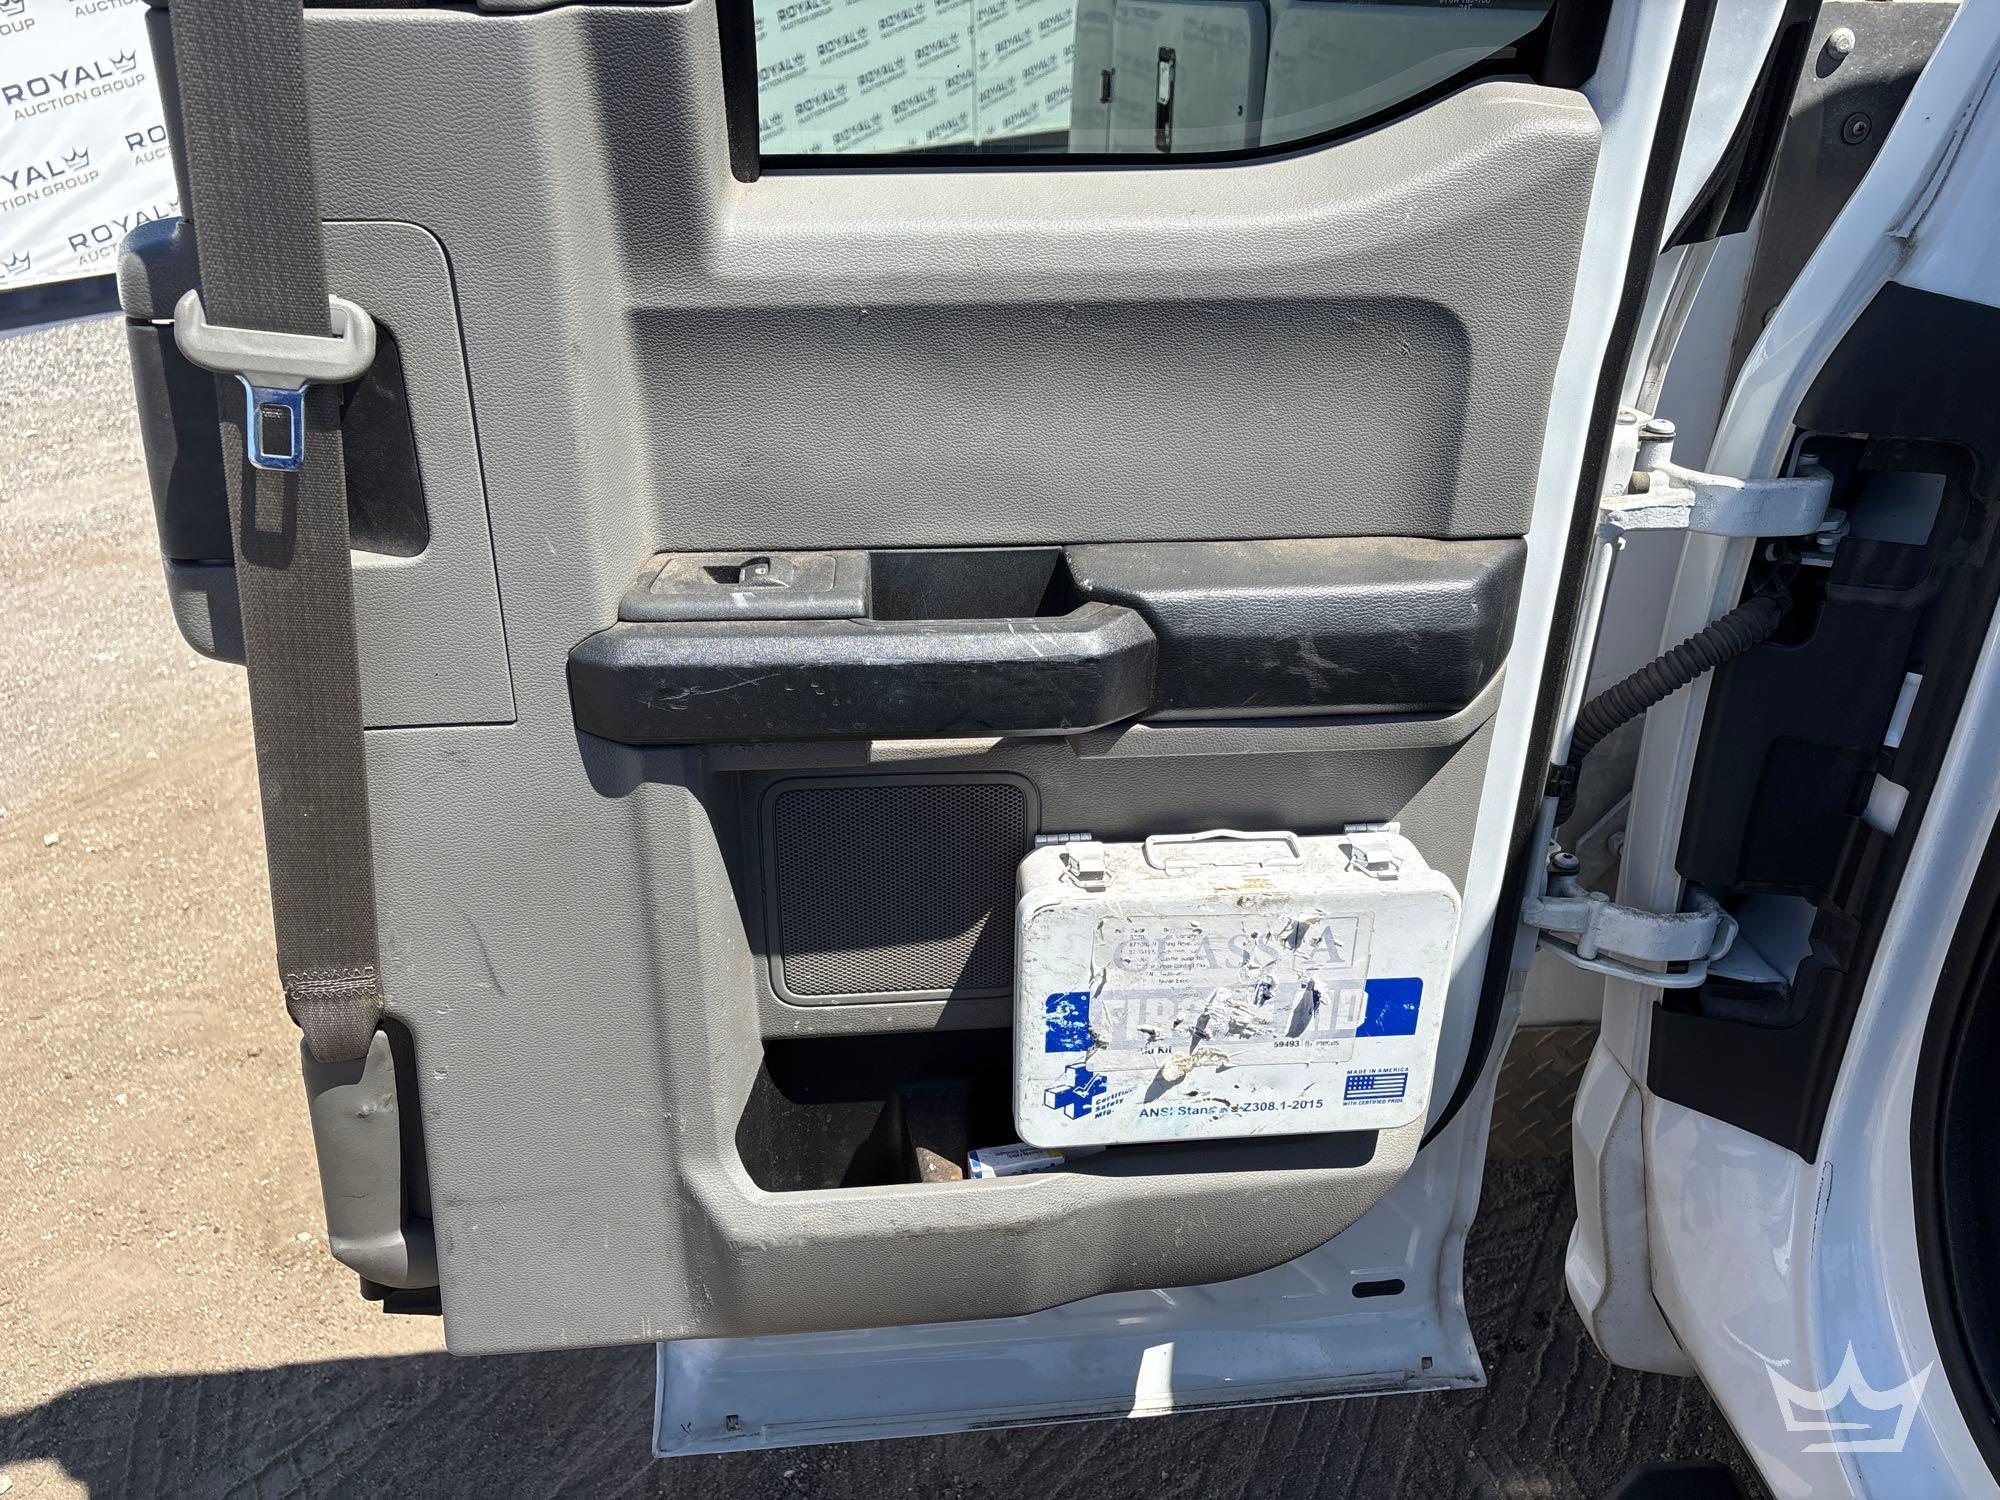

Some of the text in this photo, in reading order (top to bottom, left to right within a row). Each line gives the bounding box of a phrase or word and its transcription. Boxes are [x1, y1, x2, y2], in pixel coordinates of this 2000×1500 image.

[0, 18, 35, 36] OUP
[1, 60, 114, 105] ROYAL
[13, 73, 146, 121] AUCTION GROUP
[0, 160, 66, 191] YAL
[0, 170, 99, 213] TION GROUP
[68, 205, 170, 252] ROYAL
[78, 242, 118, 267] AUCT
[1095, 1097, 1124, 1113] Safety
